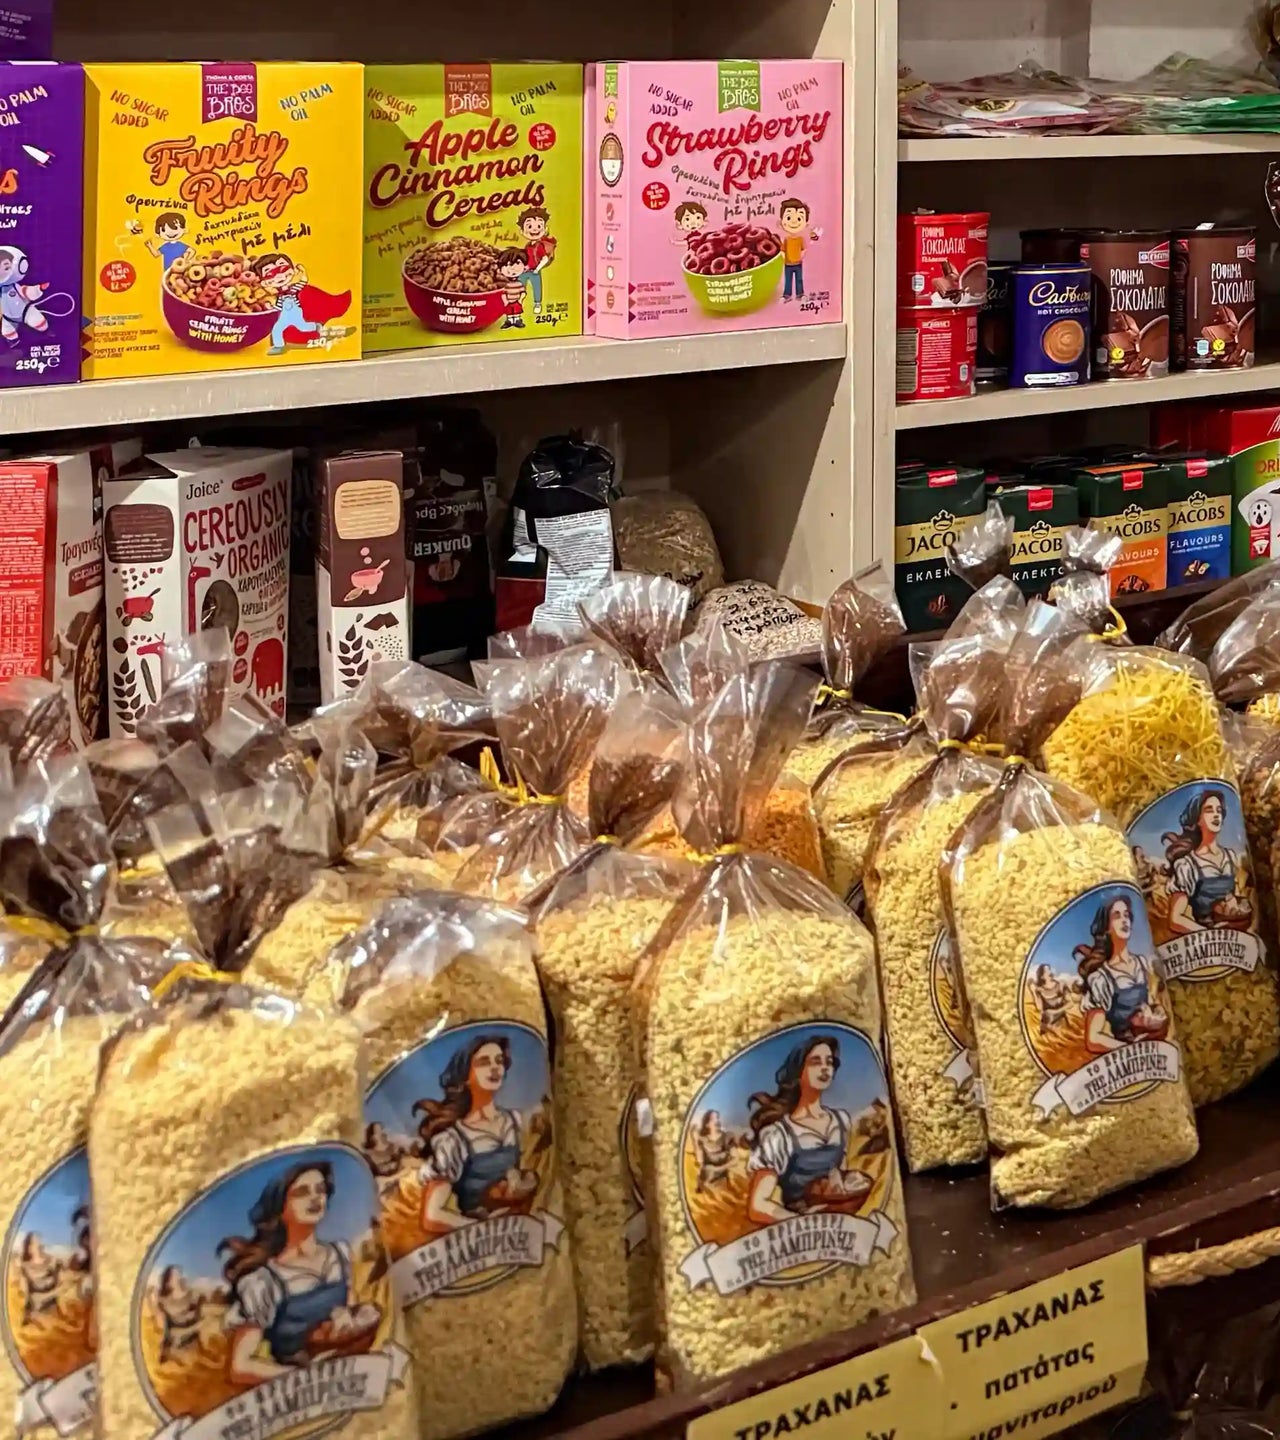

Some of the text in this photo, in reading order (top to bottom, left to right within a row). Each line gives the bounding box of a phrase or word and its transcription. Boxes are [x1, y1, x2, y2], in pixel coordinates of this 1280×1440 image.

[10, 85, 49, 109] PALM
[206, 83, 228, 95] THE
[280, 82, 333, 110] NO PALM
[528, 81, 556, 100] PALM
[110, 90, 169, 122] NO SUGAR
[369, 110, 400, 122] ADDED
[384, 95, 418, 117] SUGAR
[111, 114, 150, 128] ADDED
[404, 118, 519, 167] Apple
[642, 110, 831, 169] Strawberry
[144, 124, 289, 185] Fruity
[714, 139, 815, 195] Rings
[370, 152, 544, 208] Cinnamon
[180, 167, 309, 218] Rings
[426, 180, 545, 229] Cereals
[273, 222, 311, 248] μέλι
[922, 227, 944, 238] ΡΟΦΗΜΑ
[922, 238, 966, 254] ΣΟΚΟΛΑΤΑΣ
[1110, 268, 1144, 286] ΡΟΦΗΜΑ
[1211, 263, 1242, 279] ΡΟΦΗΜΑ
[1110, 287, 1166, 312] ΣΟΚΟΛΑΤΑΣ
[189, 319, 249, 335] CEREAL RINGS
[204, 314, 236, 326] FRUITY
[189, 329, 246, 344] WITH HONEY
[186, 481, 221, 500] Joice
[184, 479, 287, 554] CEREOUSLY
[1106, 518, 1161, 537] JACOBS
[1169, 505, 1225, 527] JACOBS
[228, 521, 289, 579] ORGANIC
[1170, 533, 1224, 550] FLAVOURS
[1185, 942, 1246, 962] ΛΑΜΠΡΙΝΗΣ
[956, 1279, 1106, 1353] ΤΡΑΧΑΝΑΣ
[984, 1341, 1096, 1400] πατάτας
[733, 1374, 893, 1440] ΤΡΑΧΑΝΑΣ
